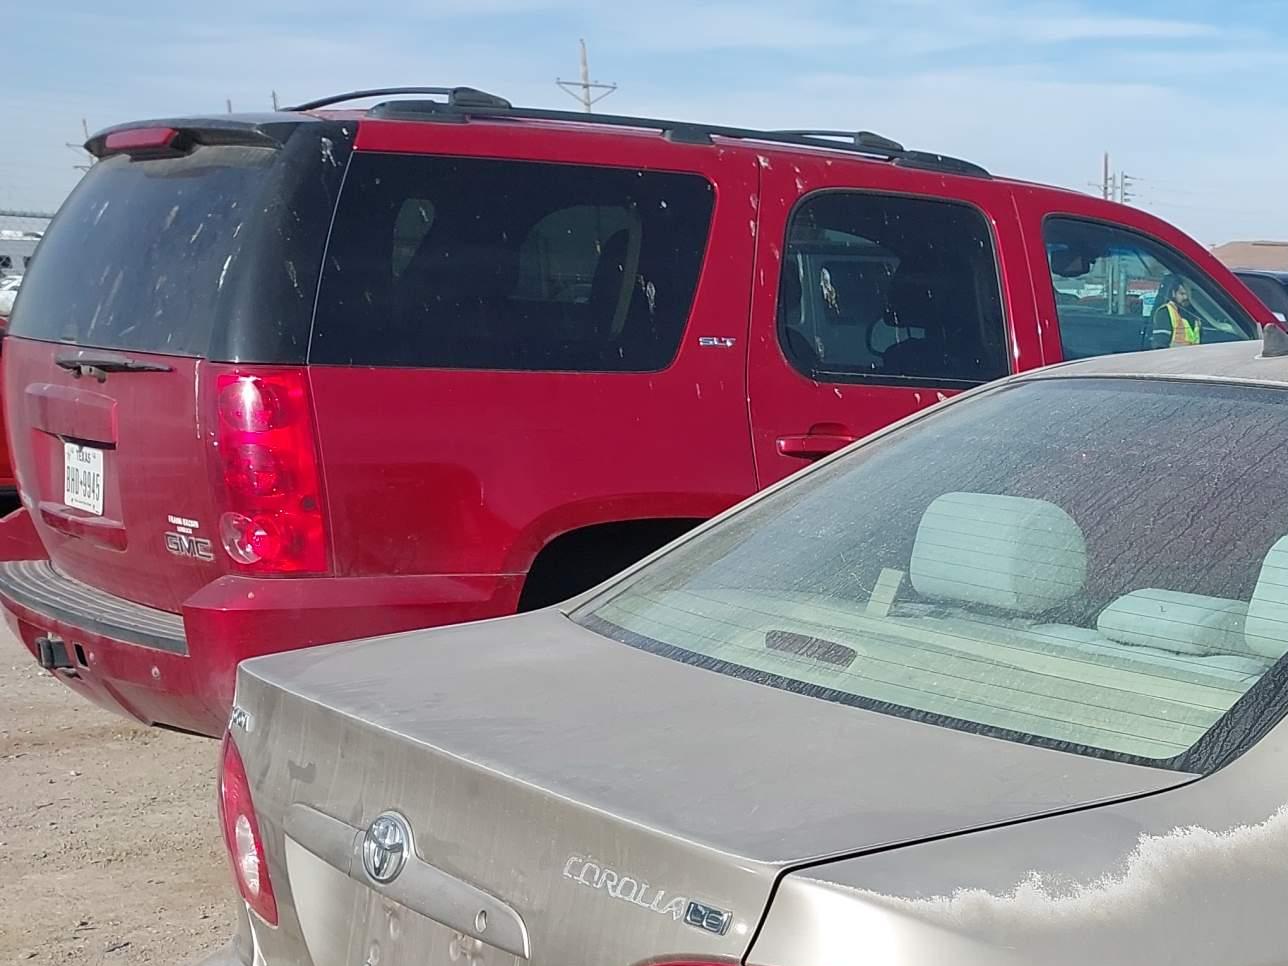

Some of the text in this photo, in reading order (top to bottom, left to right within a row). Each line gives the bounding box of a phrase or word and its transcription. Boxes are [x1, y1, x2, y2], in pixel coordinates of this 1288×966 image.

[699, 337, 736, 347] SLT
[76, 450, 91, 464] TEXAS
[165, 532, 214, 561] GMC
[563, 856, 687, 921] COROLLA
